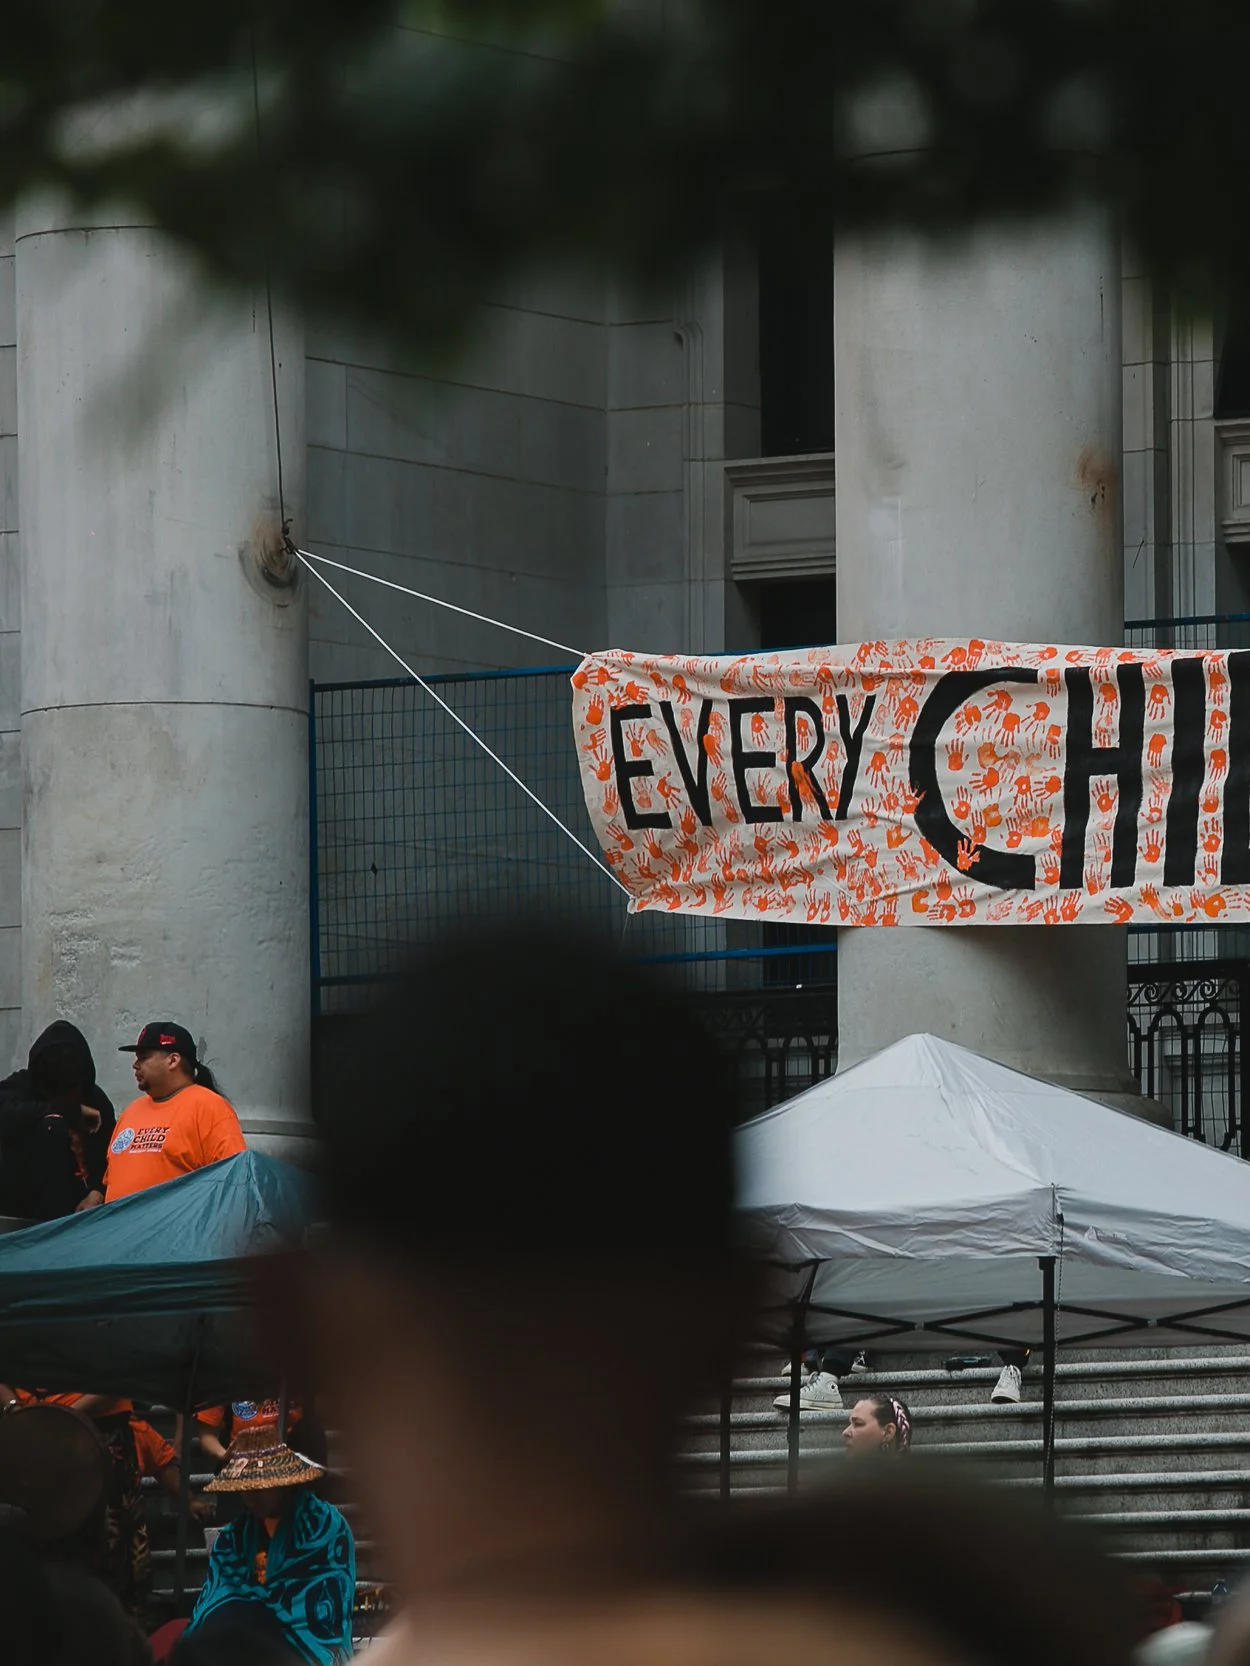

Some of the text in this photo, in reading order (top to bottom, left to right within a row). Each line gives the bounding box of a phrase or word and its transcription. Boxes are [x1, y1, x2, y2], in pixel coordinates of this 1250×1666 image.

[609, 694, 876, 830] EVERY
[137, 1127, 169, 1135] EVERY
[133, 1134, 166, 1143] CHILD
